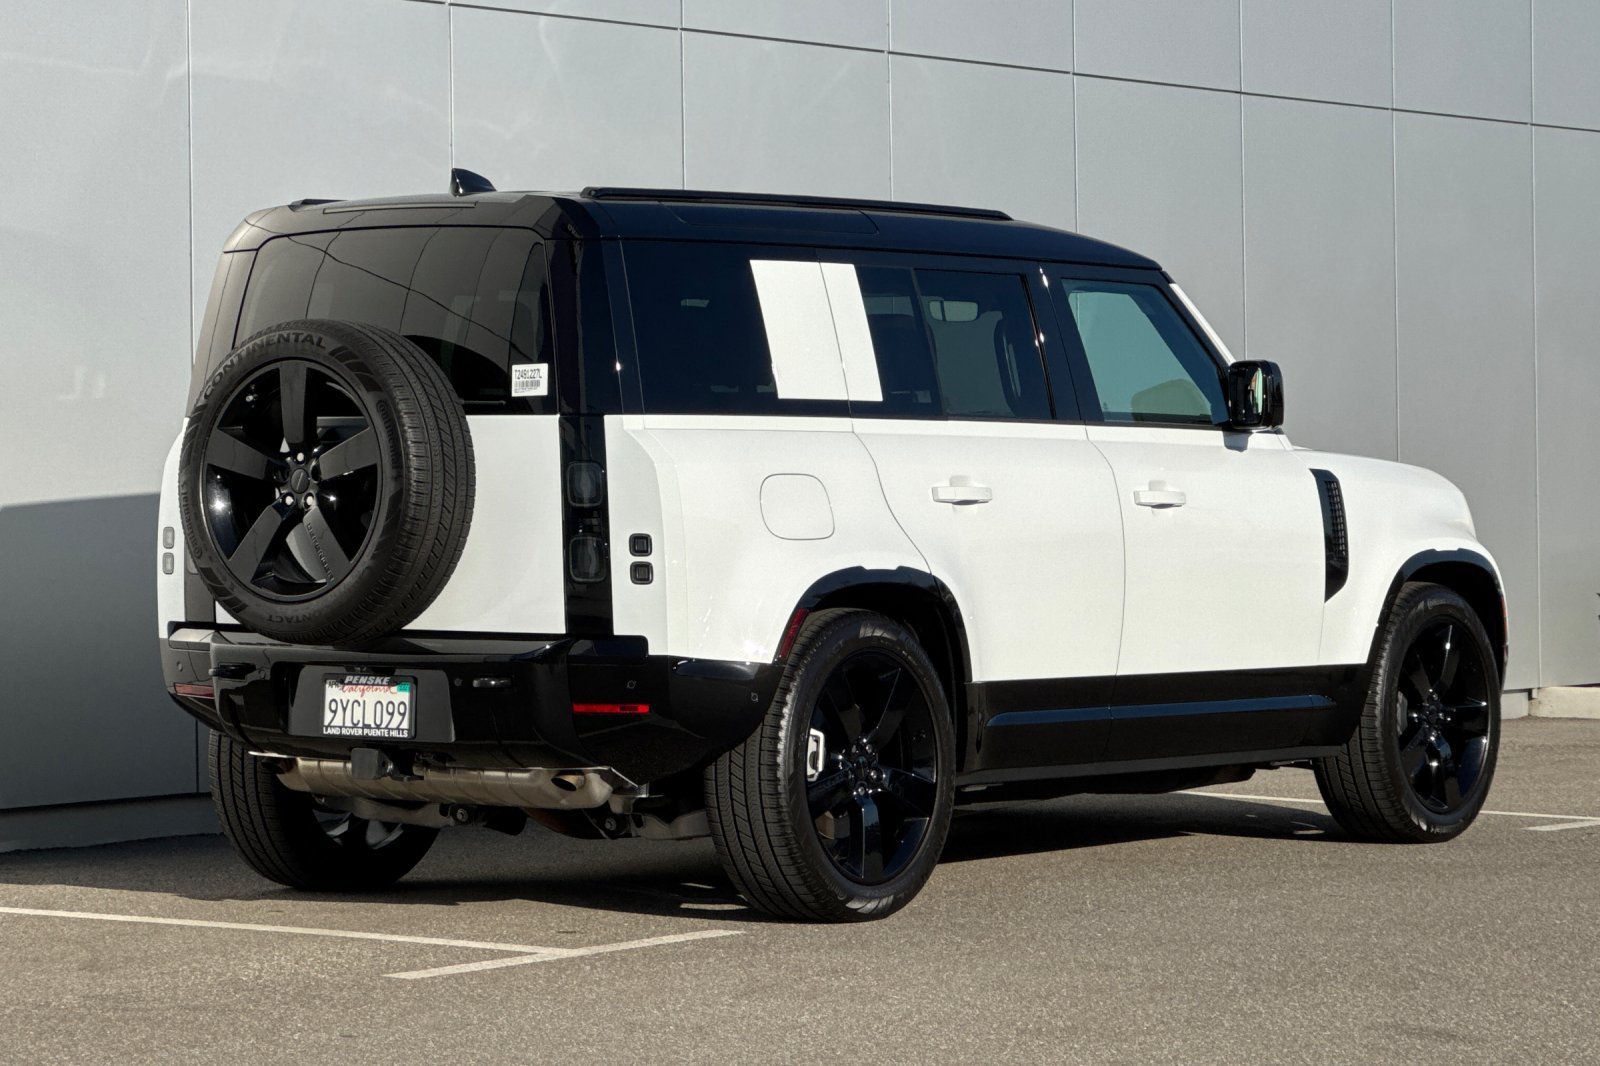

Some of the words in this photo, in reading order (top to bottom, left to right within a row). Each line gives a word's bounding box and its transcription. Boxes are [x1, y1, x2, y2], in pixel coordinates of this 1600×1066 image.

[204, 332, 326, 399] CONTINENTAL
[344, 675, 390, 685] PENSKE
[328, 699, 407, 729] 9YCL099
[323, 726, 341, 735] LAND
[341, 728, 363, 737] ROVER
[363, 729, 389, 737] PUENTE
[389, 730, 408, 738] HILLS
